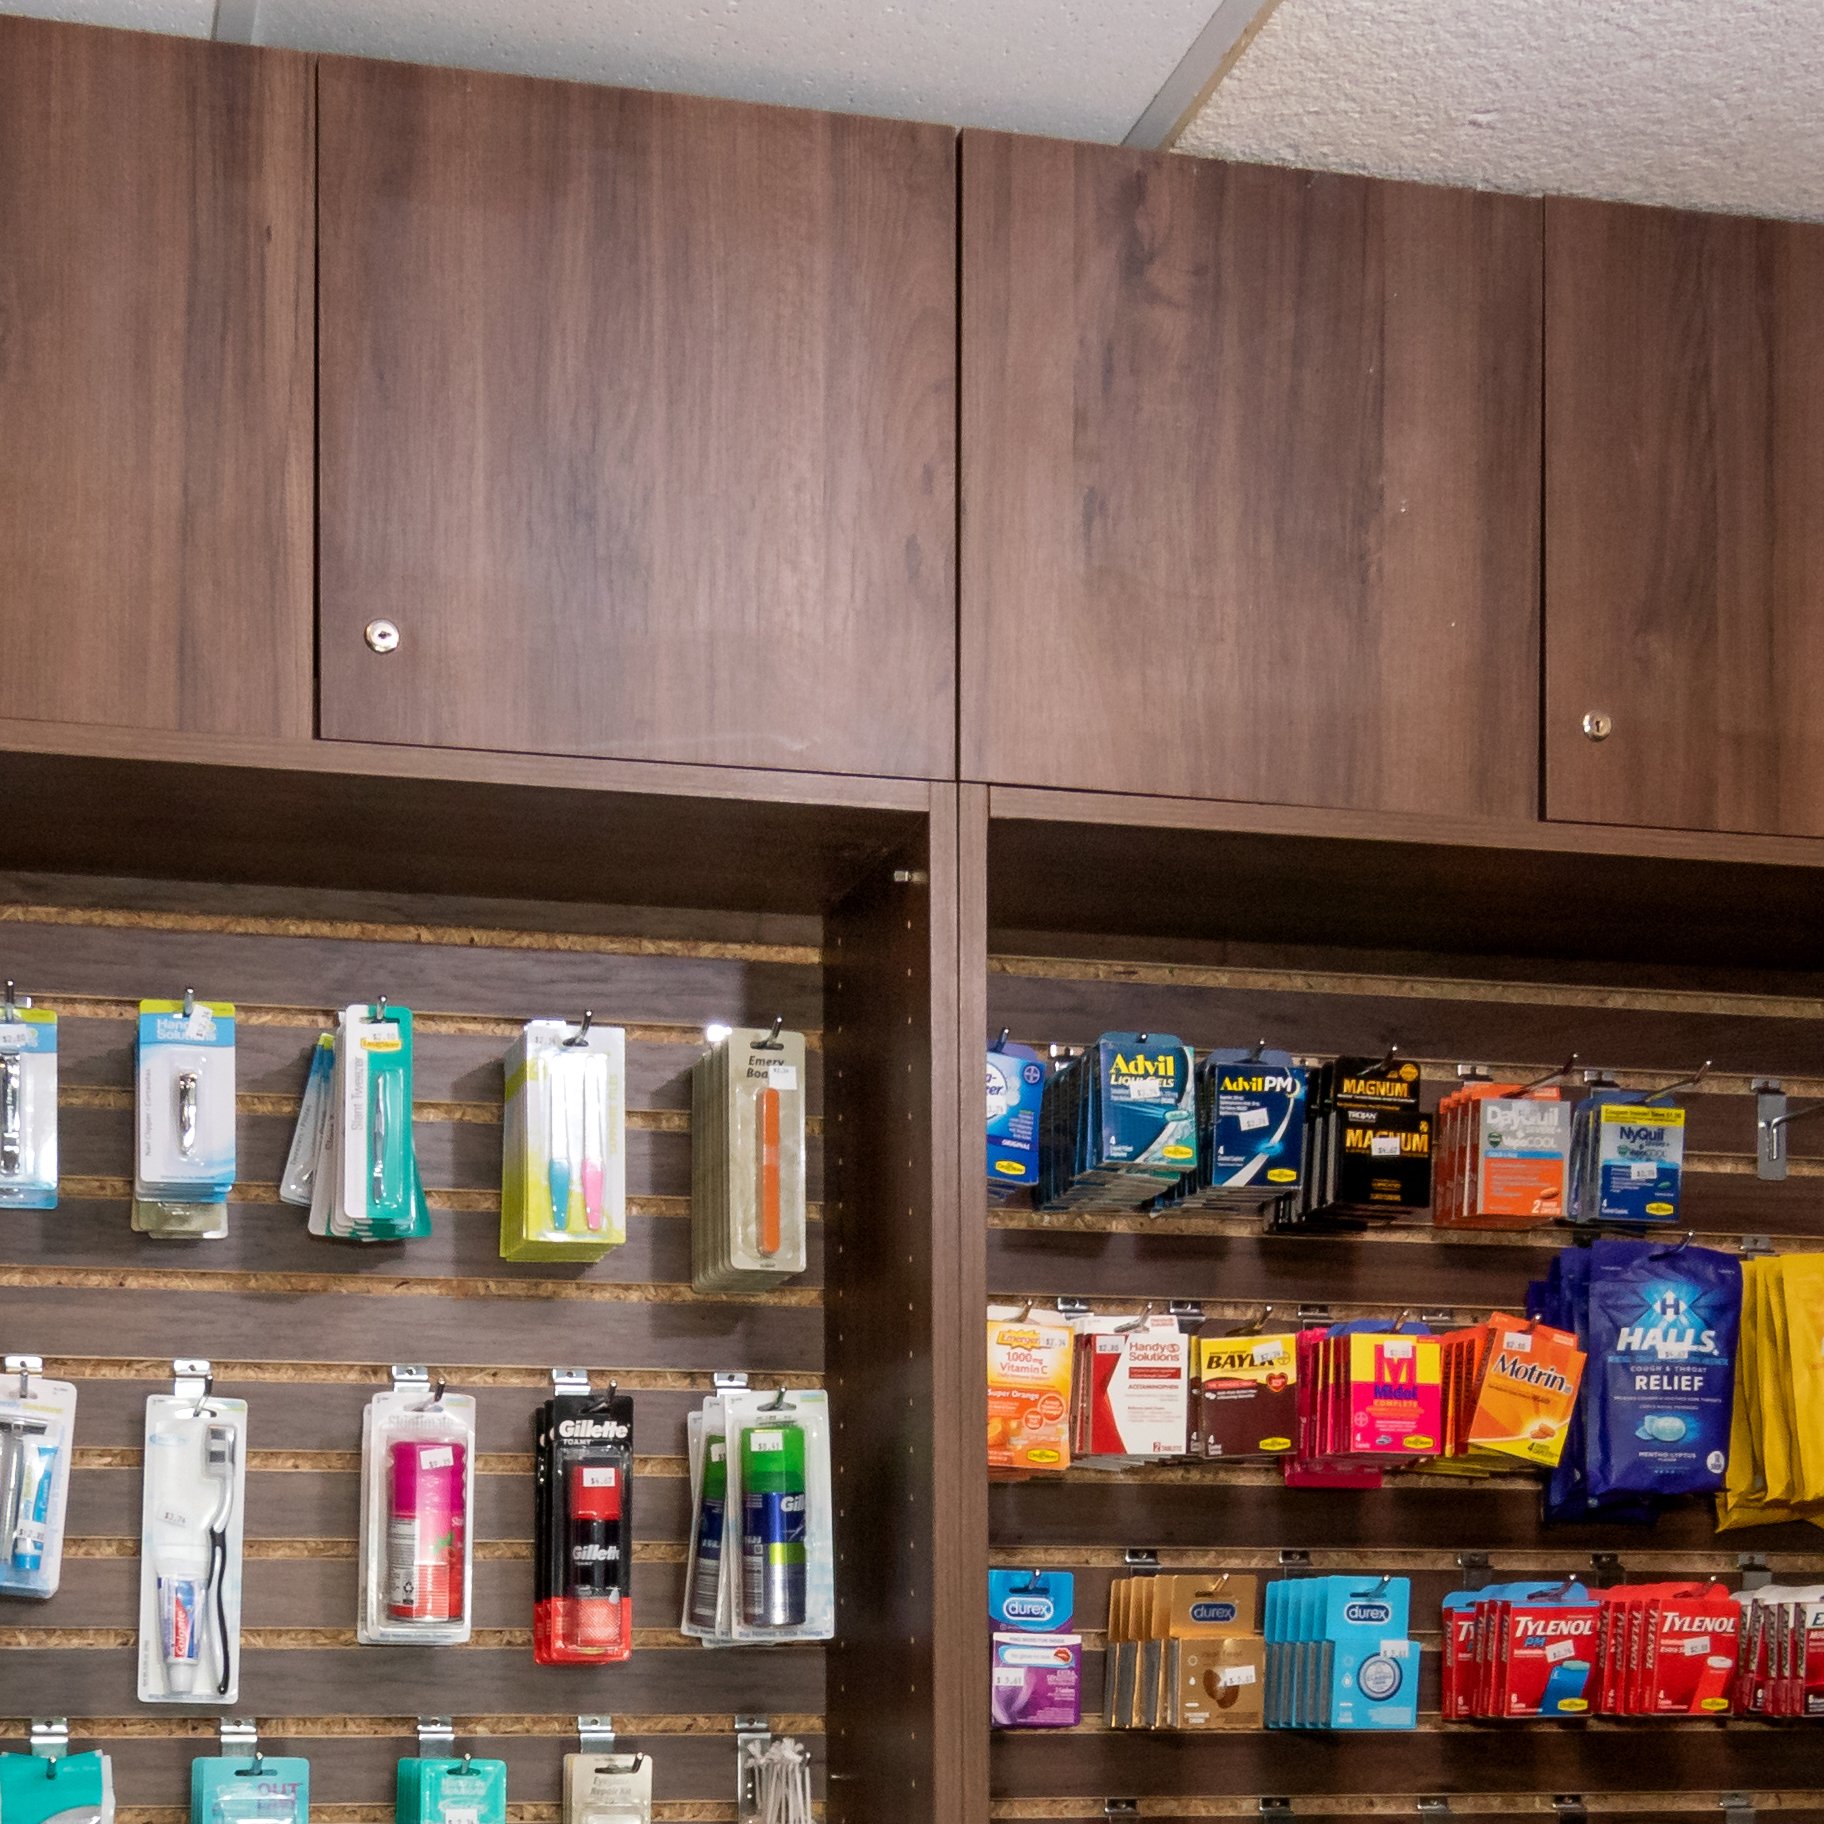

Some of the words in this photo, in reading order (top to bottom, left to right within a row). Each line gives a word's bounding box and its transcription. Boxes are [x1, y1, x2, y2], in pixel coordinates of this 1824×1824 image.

[748, 1054, 785, 1068] Emery
[1109, 1053, 1175, 1077] Advil
[350, 1056, 364, 1099] Tweezer
[1219, 1075, 1263, 1092] Advil
[1263, 1075, 1293, 1093] PM
[1342, 1079, 1409, 1098] MAGNUM
[350, 1100, 364, 1132] Slant
[1347, 1110, 1378, 1122] TROJAN
[1619, 1126, 1666, 1144] NyQuil
[1531, 1200, 1541, 1214] 2
[1128, 1342, 1166, 1355] Handy
[1616, 1326, 1714, 1355] HALLS
[1128, 1352, 1181, 1363] Solutions
[999, 1362, 1039, 1375] Vitamin
[1040, 1363, 1049, 1374] C
[1493, 1353, 1567, 1394] Motrin
[1630, 1365, 1662, 1374] COUGH
[1674, 1365, 1708, 1374] THROAT
[1374, 1384, 1418, 1400] Midol
[1633, 1374, 1705, 1393] RELIEF
[1011, 1389, 1040, 1401] Orange
[1373, 1399, 1418, 1408] COMPLETE
[558, 1419, 630, 1440] Gillette
[1007, 1600, 1050, 1617] durex
[1192, 1602, 1235, 1620] durex
[1346, 1603, 1389, 1621] durex
[1514, 1615, 1596, 1638] TYLENOL
[1661, 1611, 1737, 1634] TYLENOL
[1523, 1636, 1546, 1648] PM
